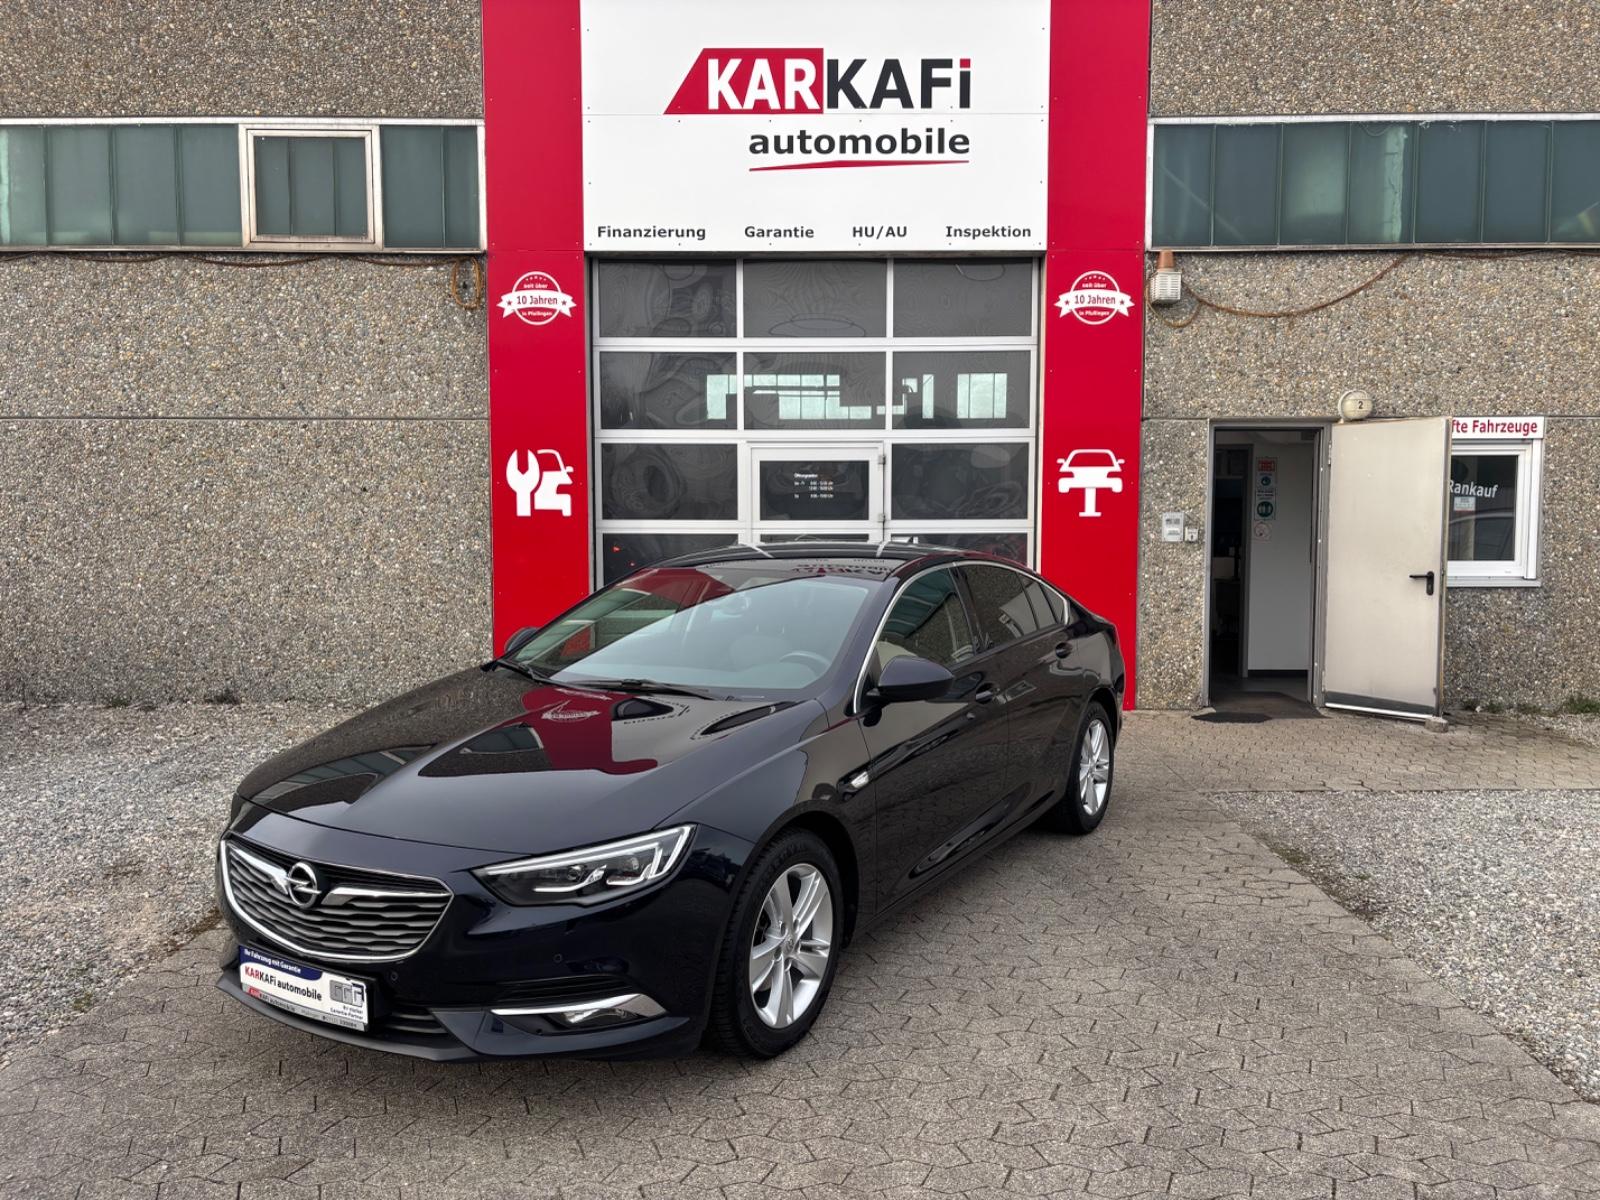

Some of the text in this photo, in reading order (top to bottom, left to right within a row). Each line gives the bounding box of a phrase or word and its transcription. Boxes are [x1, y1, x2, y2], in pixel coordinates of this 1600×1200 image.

[749, 128, 969, 154] automobile
[597, 225, 1032, 241] Finanzierung Garantie HU/AU Inspektion
[516, 295, 558, 305] 10 Jahren
[1074, 294, 1116, 305] 10 Jahren
[1358, 400, 1364, 410] 2
[1472, 419, 1538, 437] Fahrzeuge
[277, 979, 322, 1001] automobile
